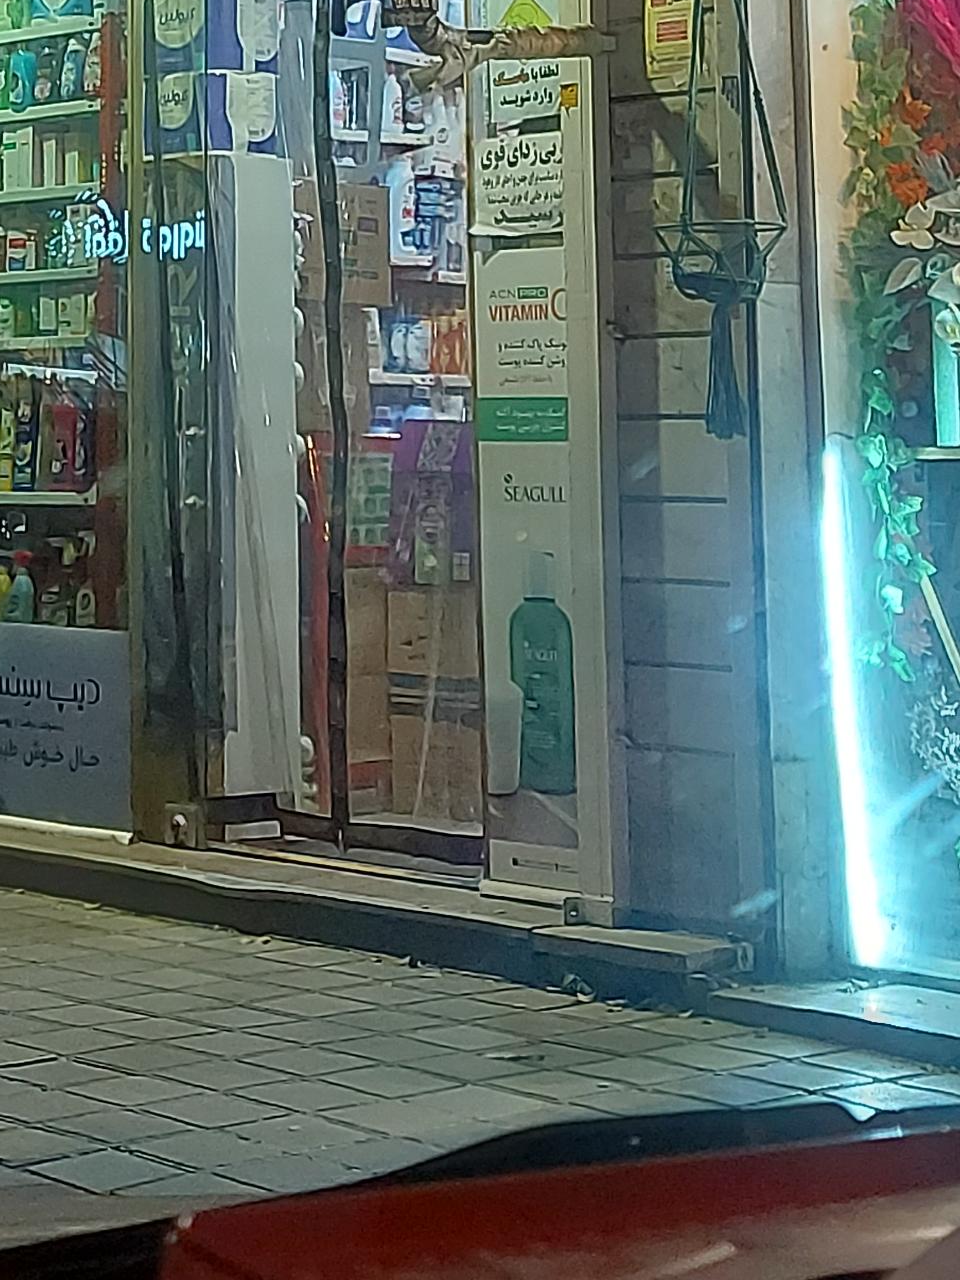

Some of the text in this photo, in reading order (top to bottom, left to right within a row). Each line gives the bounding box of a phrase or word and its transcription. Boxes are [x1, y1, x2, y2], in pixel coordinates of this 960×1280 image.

[539, 63, 560, 79] لطفا
[500, 87, 553, 108] وارد شوید
[480, 138, 505, 171] قوی
[518, 287, 548, 299] PRO
[488, 304, 549, 322] VITAMIN
[546, 354, 566, 368] وشن
[504, 485, 567, 503] SEAGULL
[23, 740, 64, 768] خوش
[68, 745, 100, 772] حال
